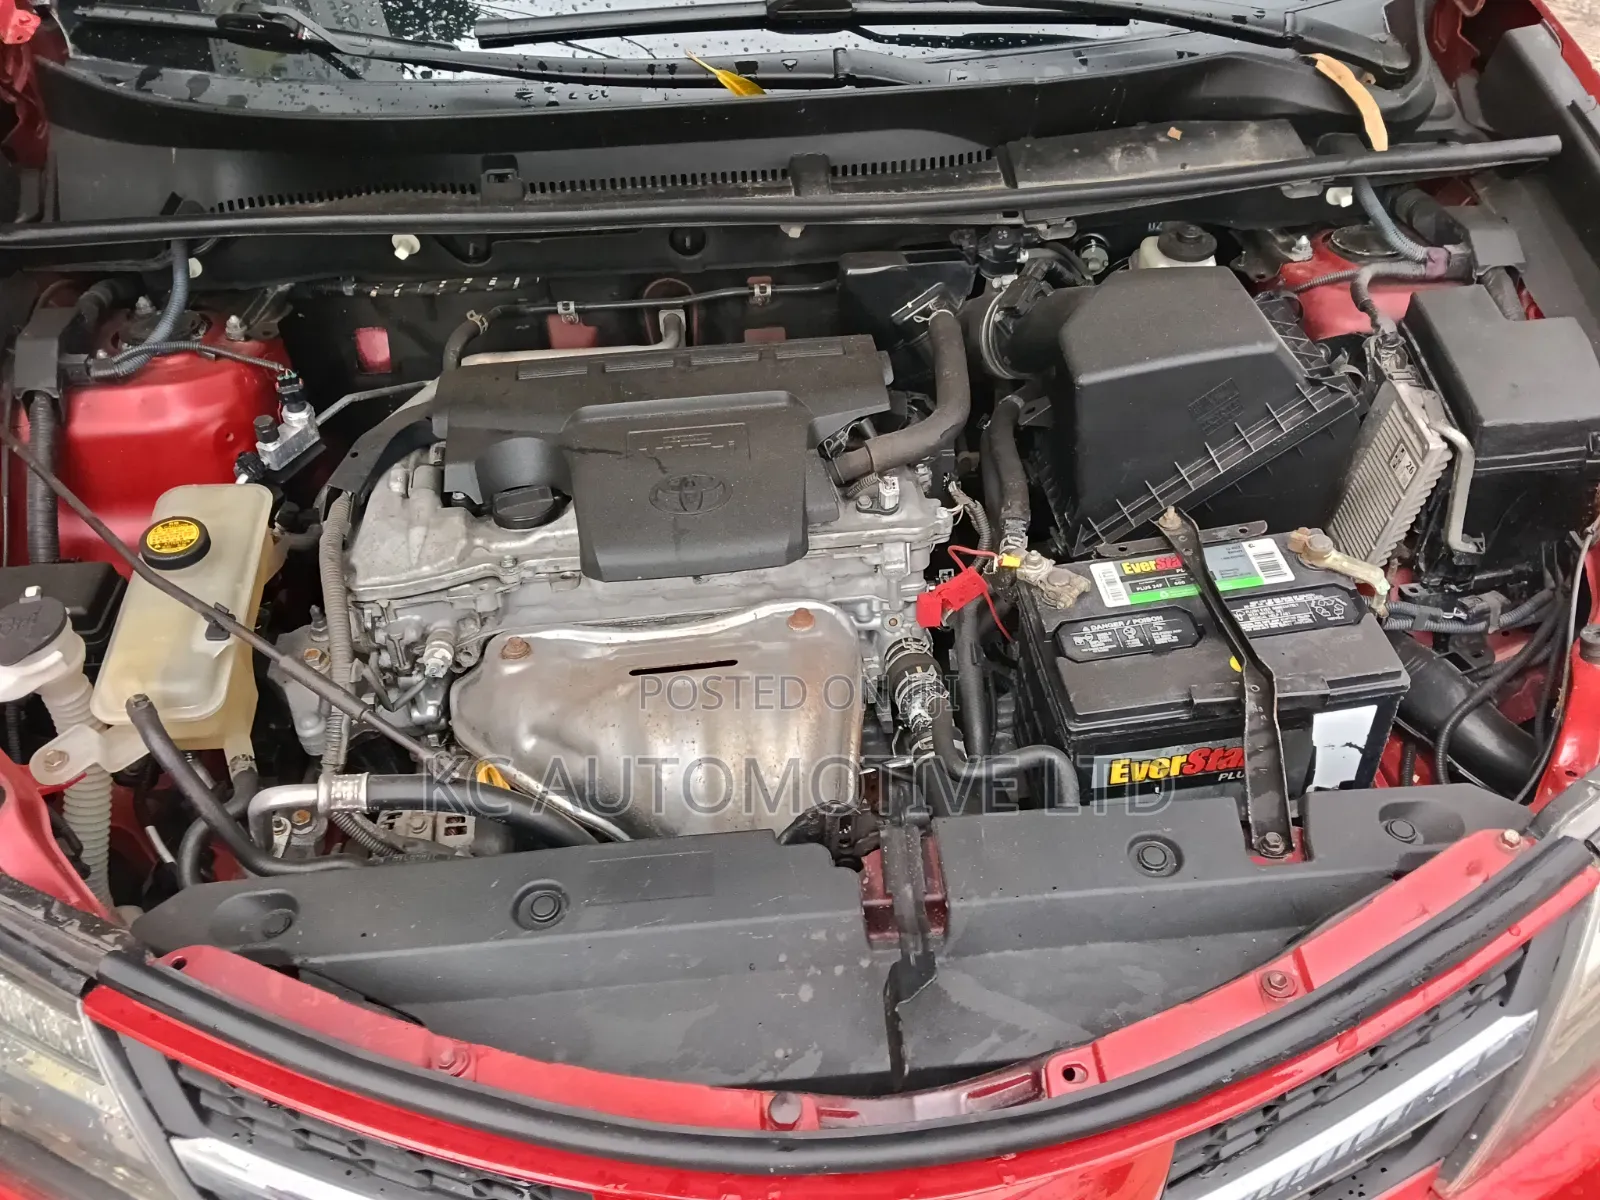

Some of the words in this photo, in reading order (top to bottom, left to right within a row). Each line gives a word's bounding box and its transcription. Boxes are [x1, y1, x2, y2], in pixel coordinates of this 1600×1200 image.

[1121, 556, 1182, 575] EverSta
[1091, 621, 1125, 631] DANGER
[1133, 616, 1163, 625] POISON
[1109, 747, 1244, 786] EverSta
[1218, 771, 1244, 782] PLU
